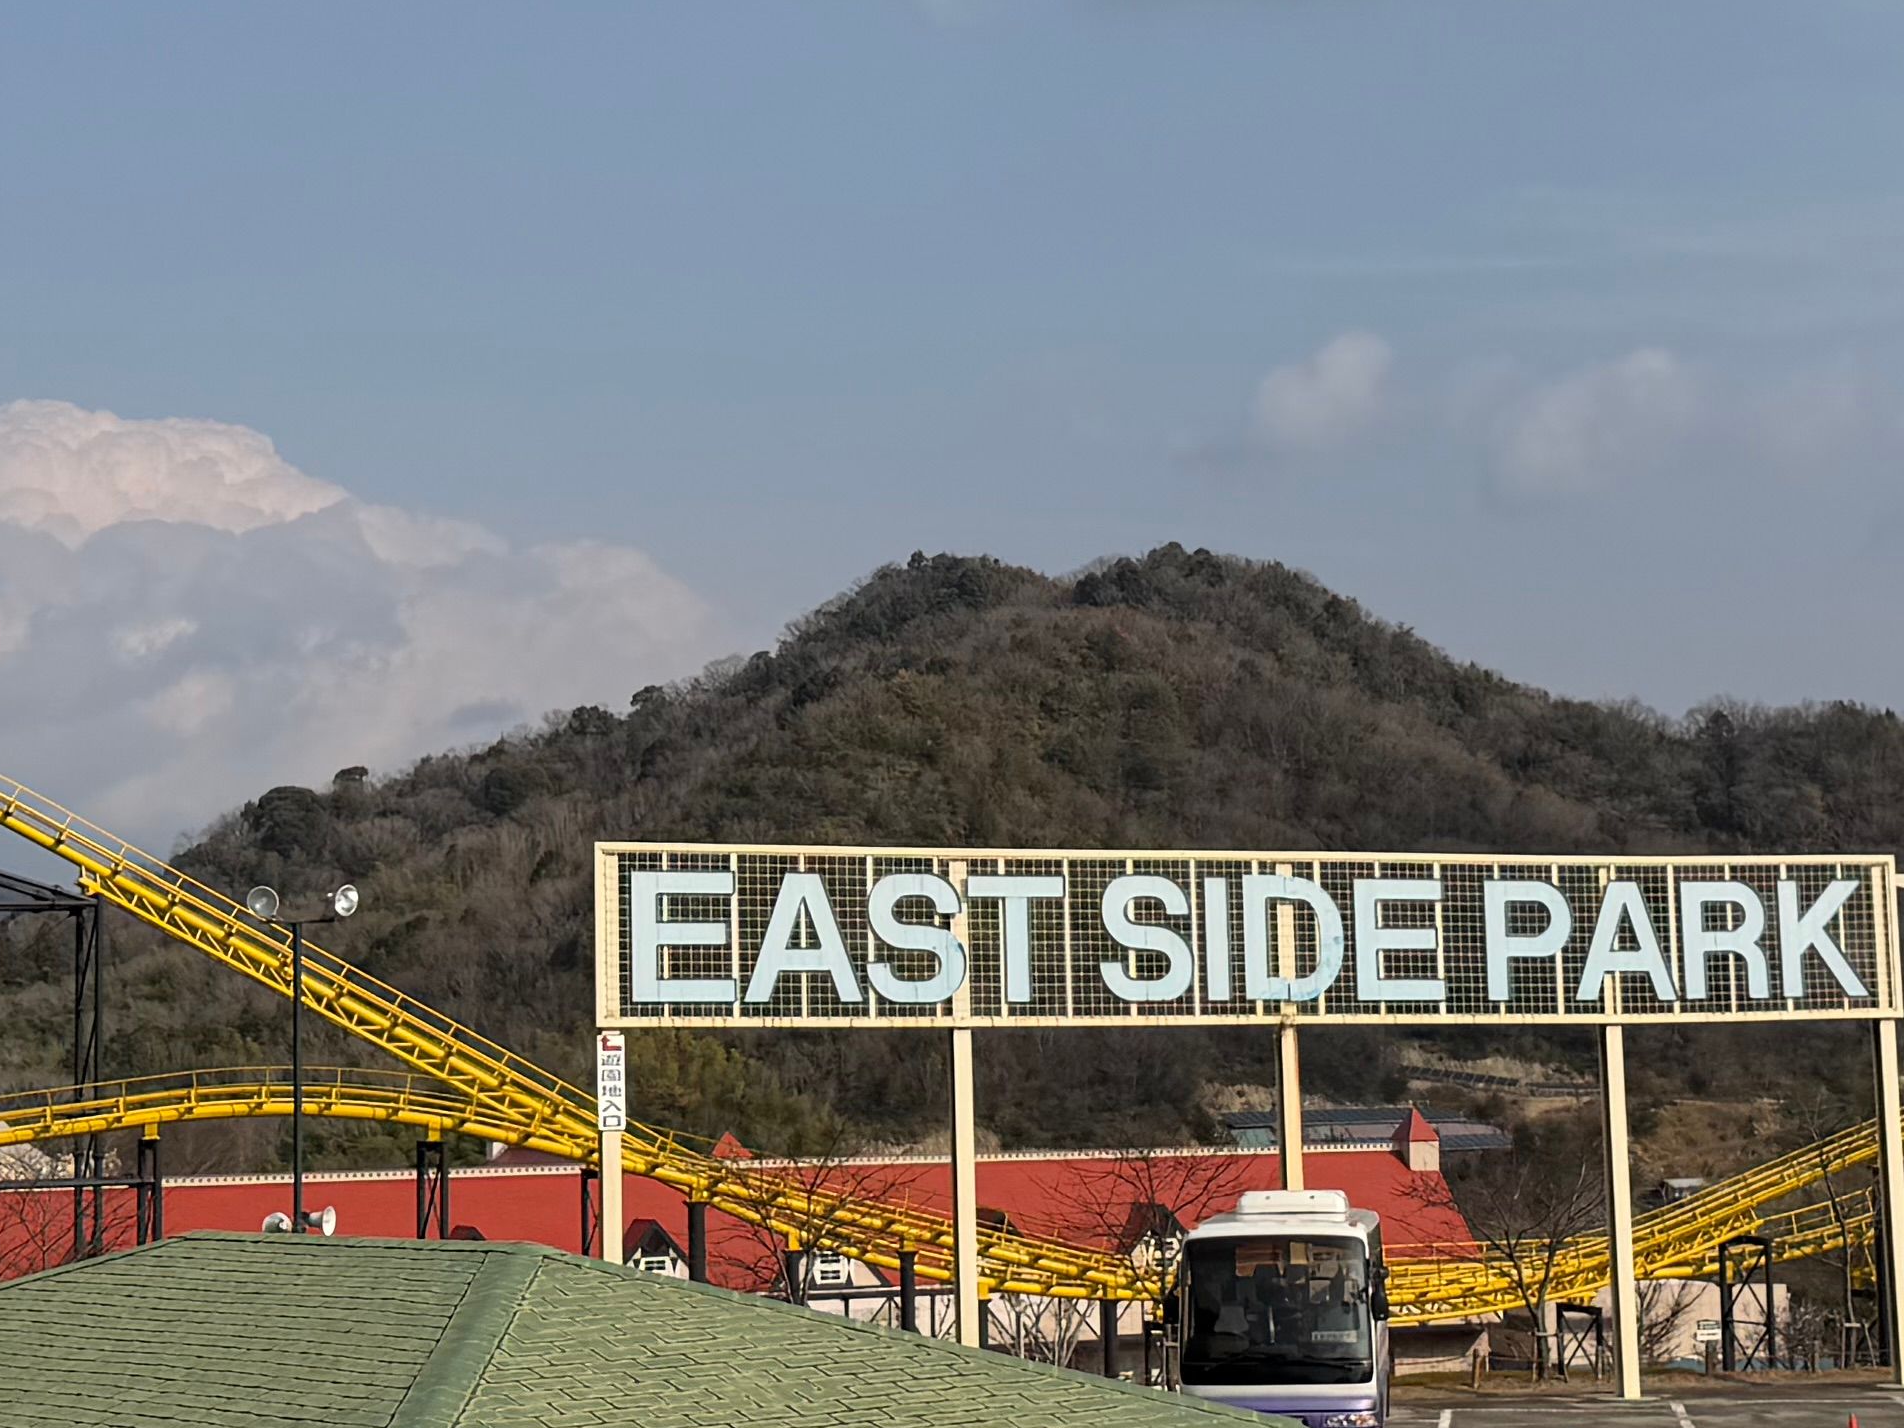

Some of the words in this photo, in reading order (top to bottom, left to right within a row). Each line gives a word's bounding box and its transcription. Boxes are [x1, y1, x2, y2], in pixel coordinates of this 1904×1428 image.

[630, 870, 1065, 1004] EAST
[1099, 874, 1446, 1003] SIDE
[1486, 879, 1871, 1001] PARK
[601, 1054, 622, 1128] 遊園地入口
